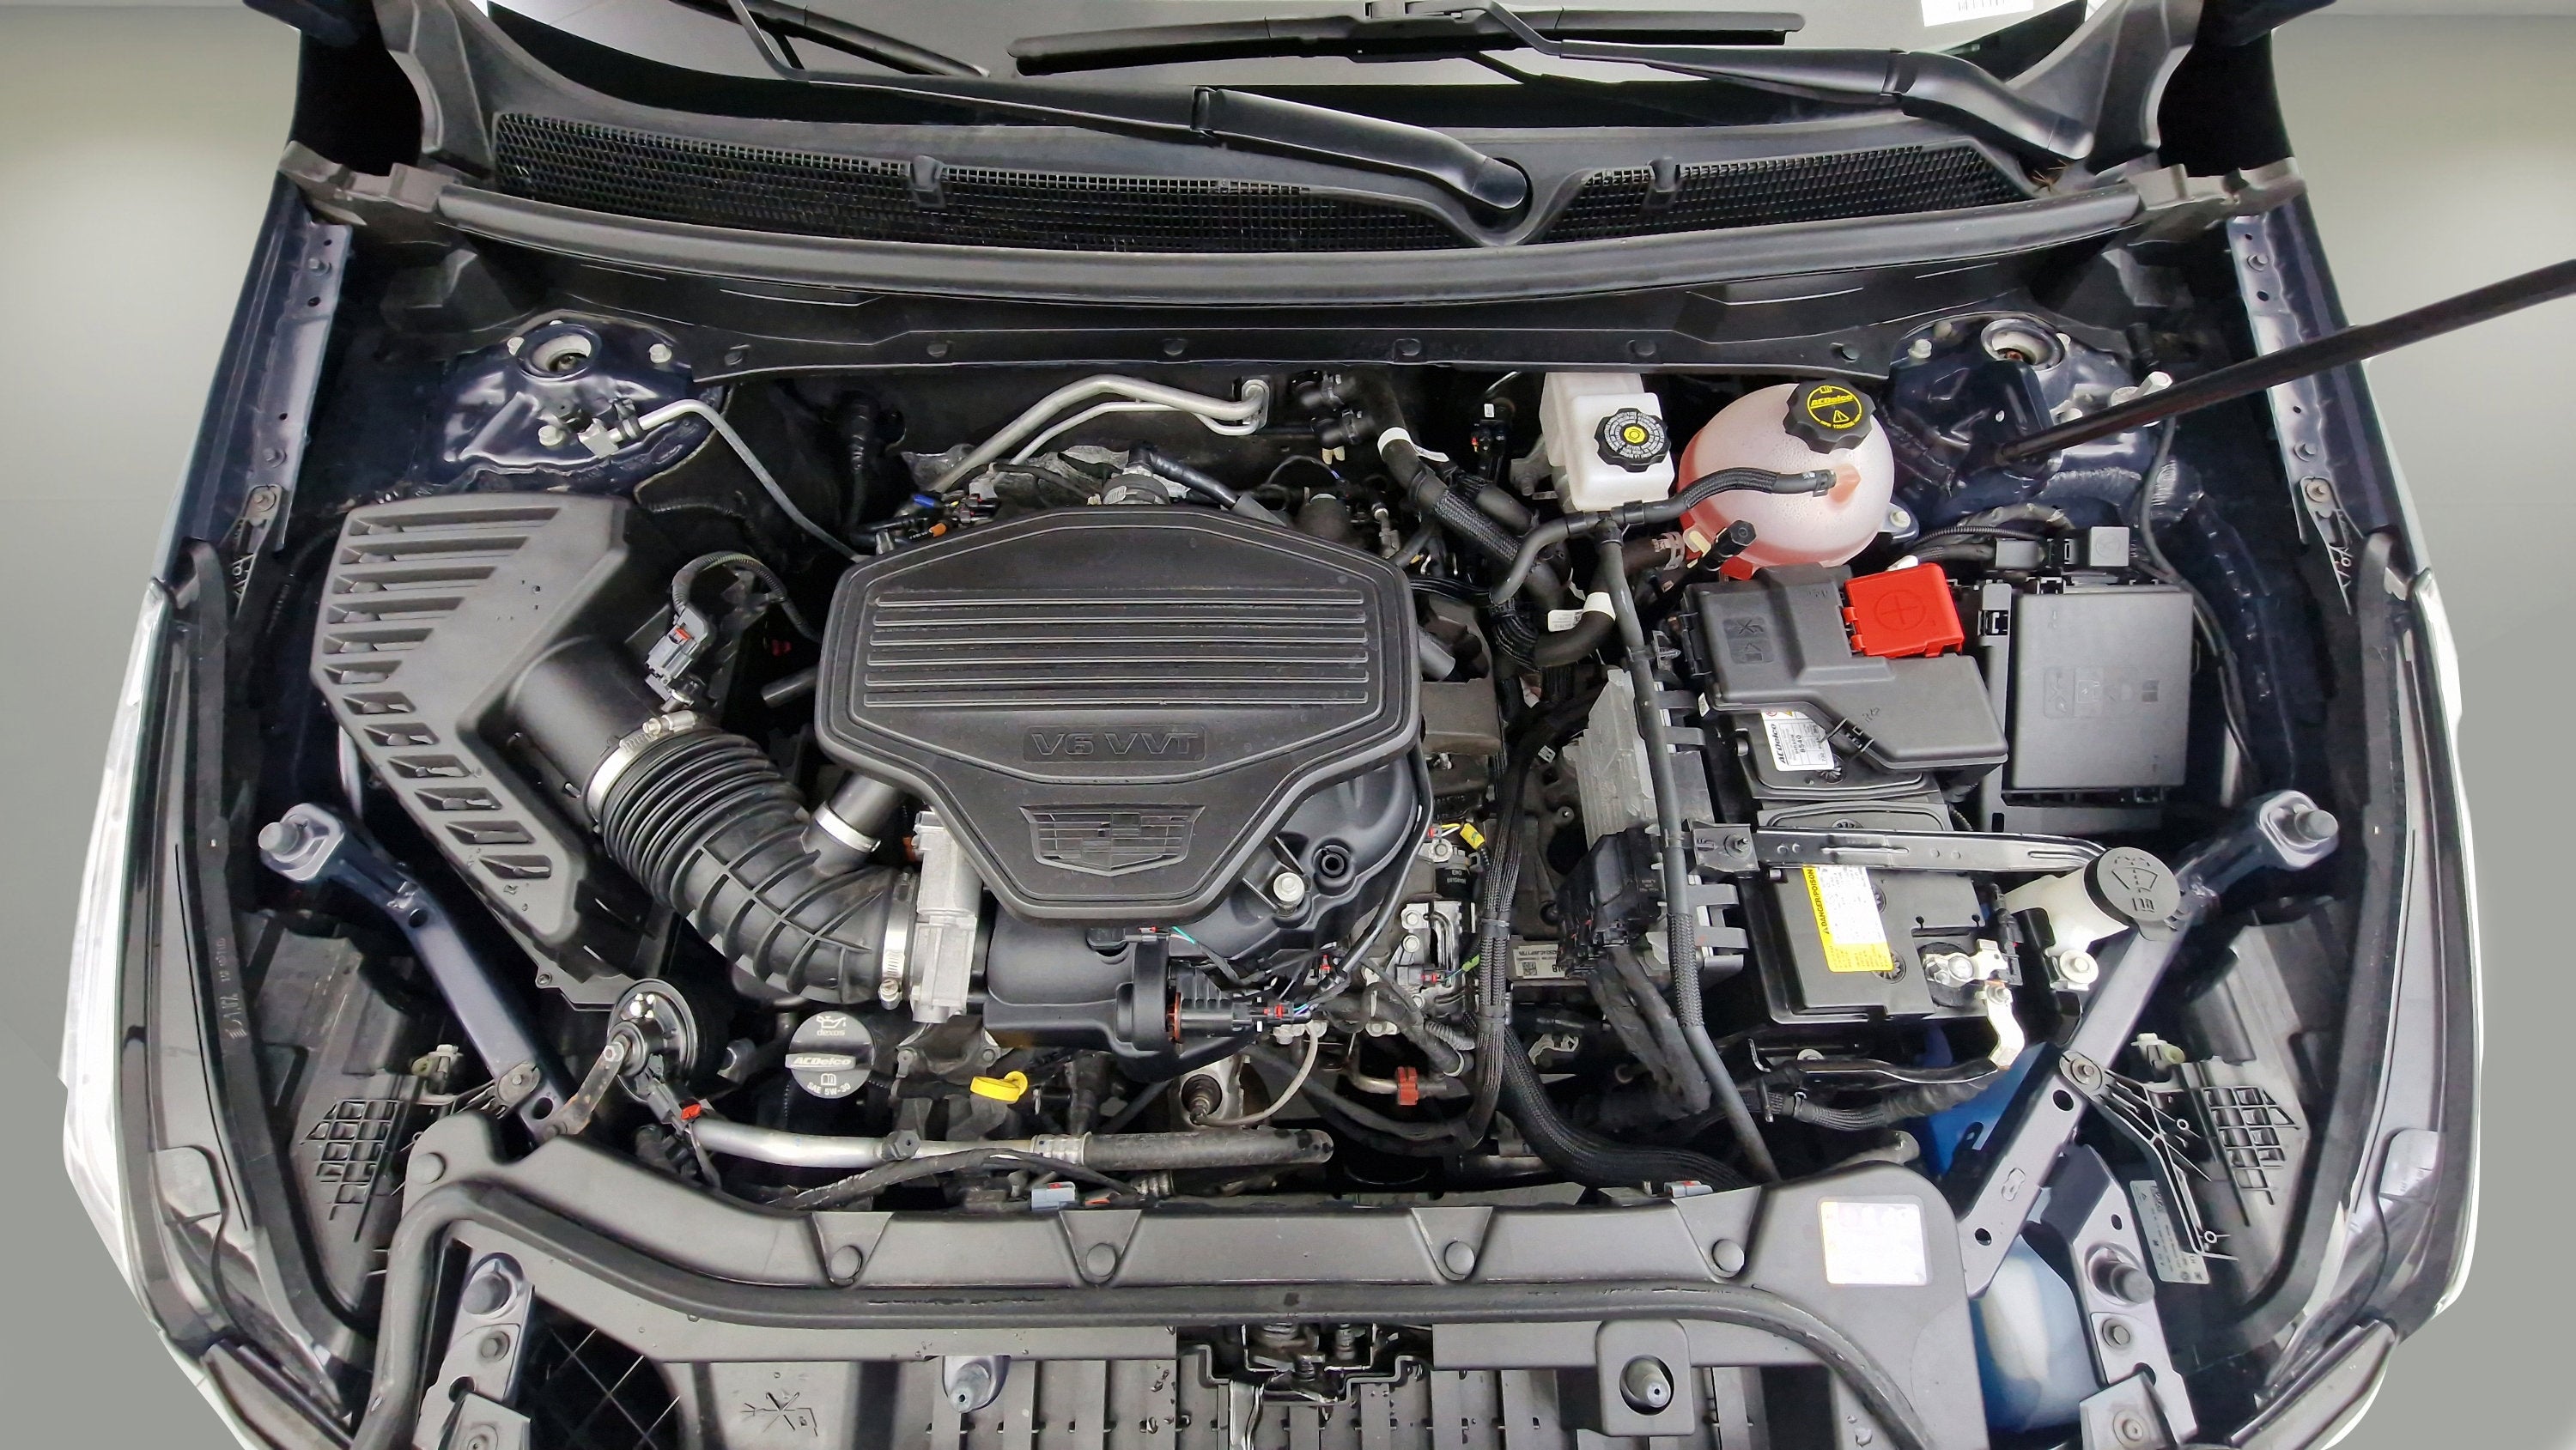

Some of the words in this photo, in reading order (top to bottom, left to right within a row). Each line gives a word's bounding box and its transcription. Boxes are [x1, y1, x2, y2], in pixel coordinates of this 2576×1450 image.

[1811, 395, 1853, 406] ACDelco
[1032, 732, 1094, 755] V6
[1104, 732, 1199, 755] VVT
[1771, 724, 1786, 764] ACDelco
[793, 1057, 852, 1065] ACDelco
[807, 1082, 822, 1094] SAE
[824, 1083, 851, 1095] 5W-30
